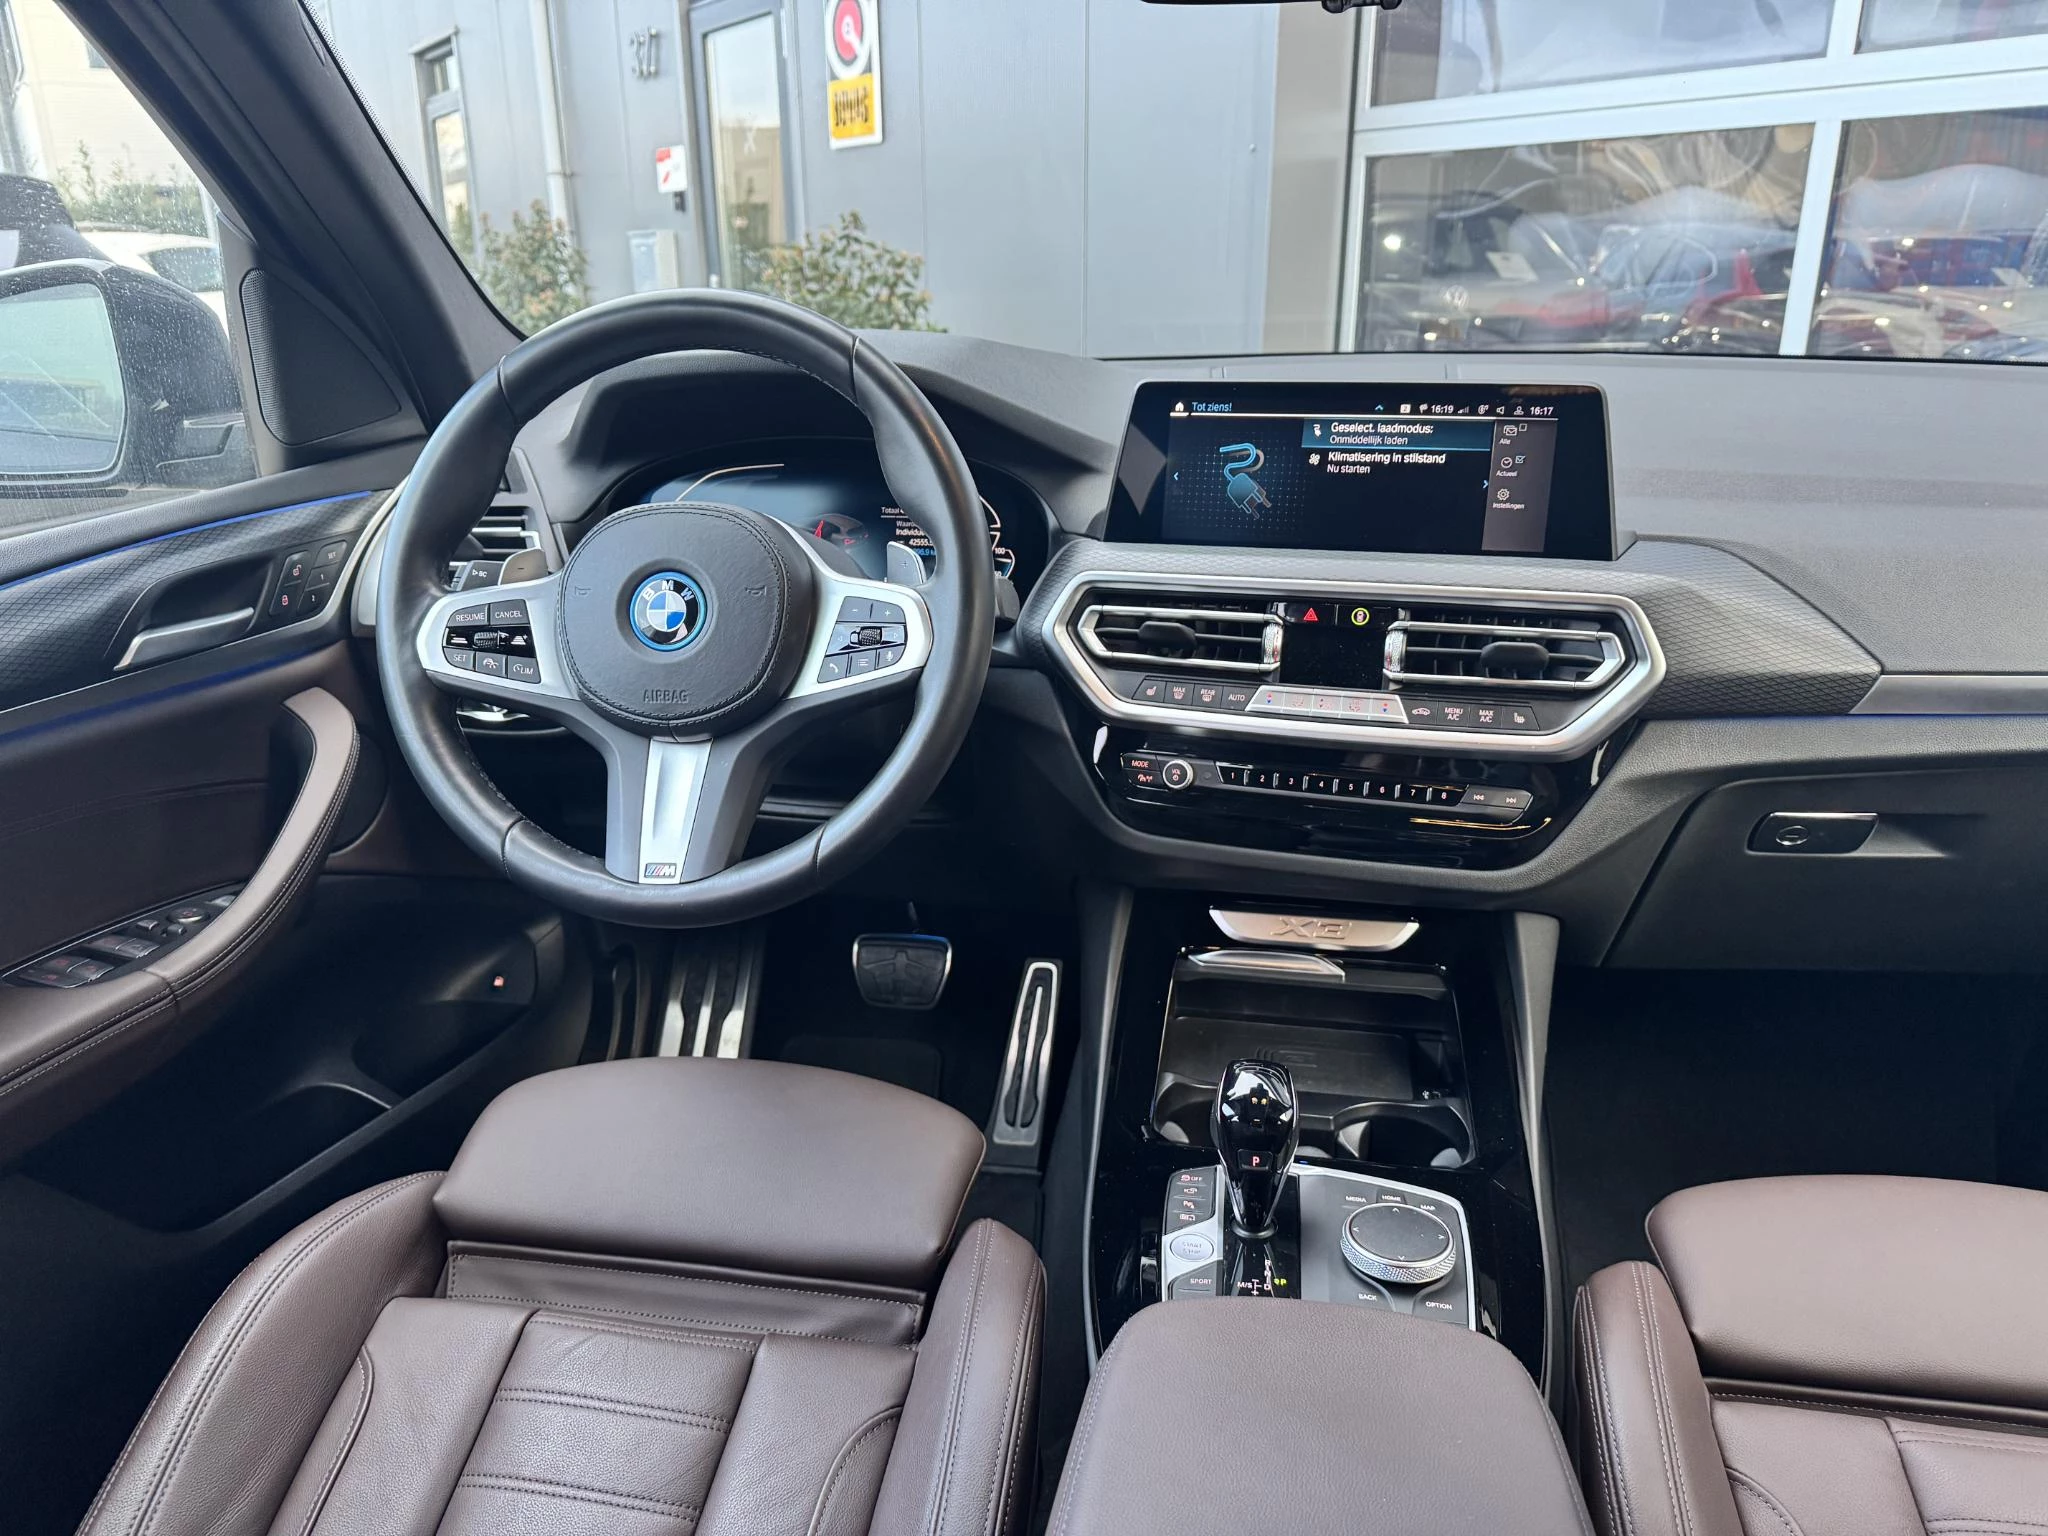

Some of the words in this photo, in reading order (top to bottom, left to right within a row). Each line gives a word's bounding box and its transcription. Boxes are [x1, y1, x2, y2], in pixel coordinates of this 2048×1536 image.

[1191, 402, 1206, 411] Tot
[1207, 402, 1233, 412] ziens!
[1430, 404, 1454, 414] 16:19
[1529, 406, 1554, 415] 16:17
[1330, 421, 1375, 433] Geselect.
[1377, 422, 1434, 434] laadmodus:
[1329, 435, 1383, 446] Onmiddellijk
[1384, 436, 1408, 445] laden
[1328, 451, 1391, 465] Klimatisering
[1392, 453, 1402, 463] in
[1403, 453, 1446, 464] stilstand
[1326, 464, 1339, 473] Nu
[1340, 464, 1371, 474] starten
[881, 506, 900, 514] Totaal
[1492, 502, 1525, 510] Instellingen
[994, 547, 1006, 555] 100
[642, 579, 695, 601] BMW
[455, 612, 485, 622] RESUME
[494, 610, 523, 619] CANCEL
[453, 654, 467, 662] SET
[520, 666, 534, 675] LIM
[643, 688, 689, 704] AIRBAG
[1200, 688, 1216, 696] REAR
[1228, 693, 1246, 702] AUTO
[1444, 706, 1464, 715] MENU
[1131, 759, 1149, 768] MODE
[1259, 774, 1265, 782] 2
[1288, 777, 1294, 785] 3
[1318, 780, 1324, 788] 4
[1441, 791, 1447, 799] 8
[1252, 1156, 1260, 1167] P
[1345, 1195, 1367, 1203] MEDIA
[1381, 1194, 1402, 1202] HOME
[1358, 1293, 1377, 1301] BACK
[1425, 1300, 1453, 1310] OPTION
